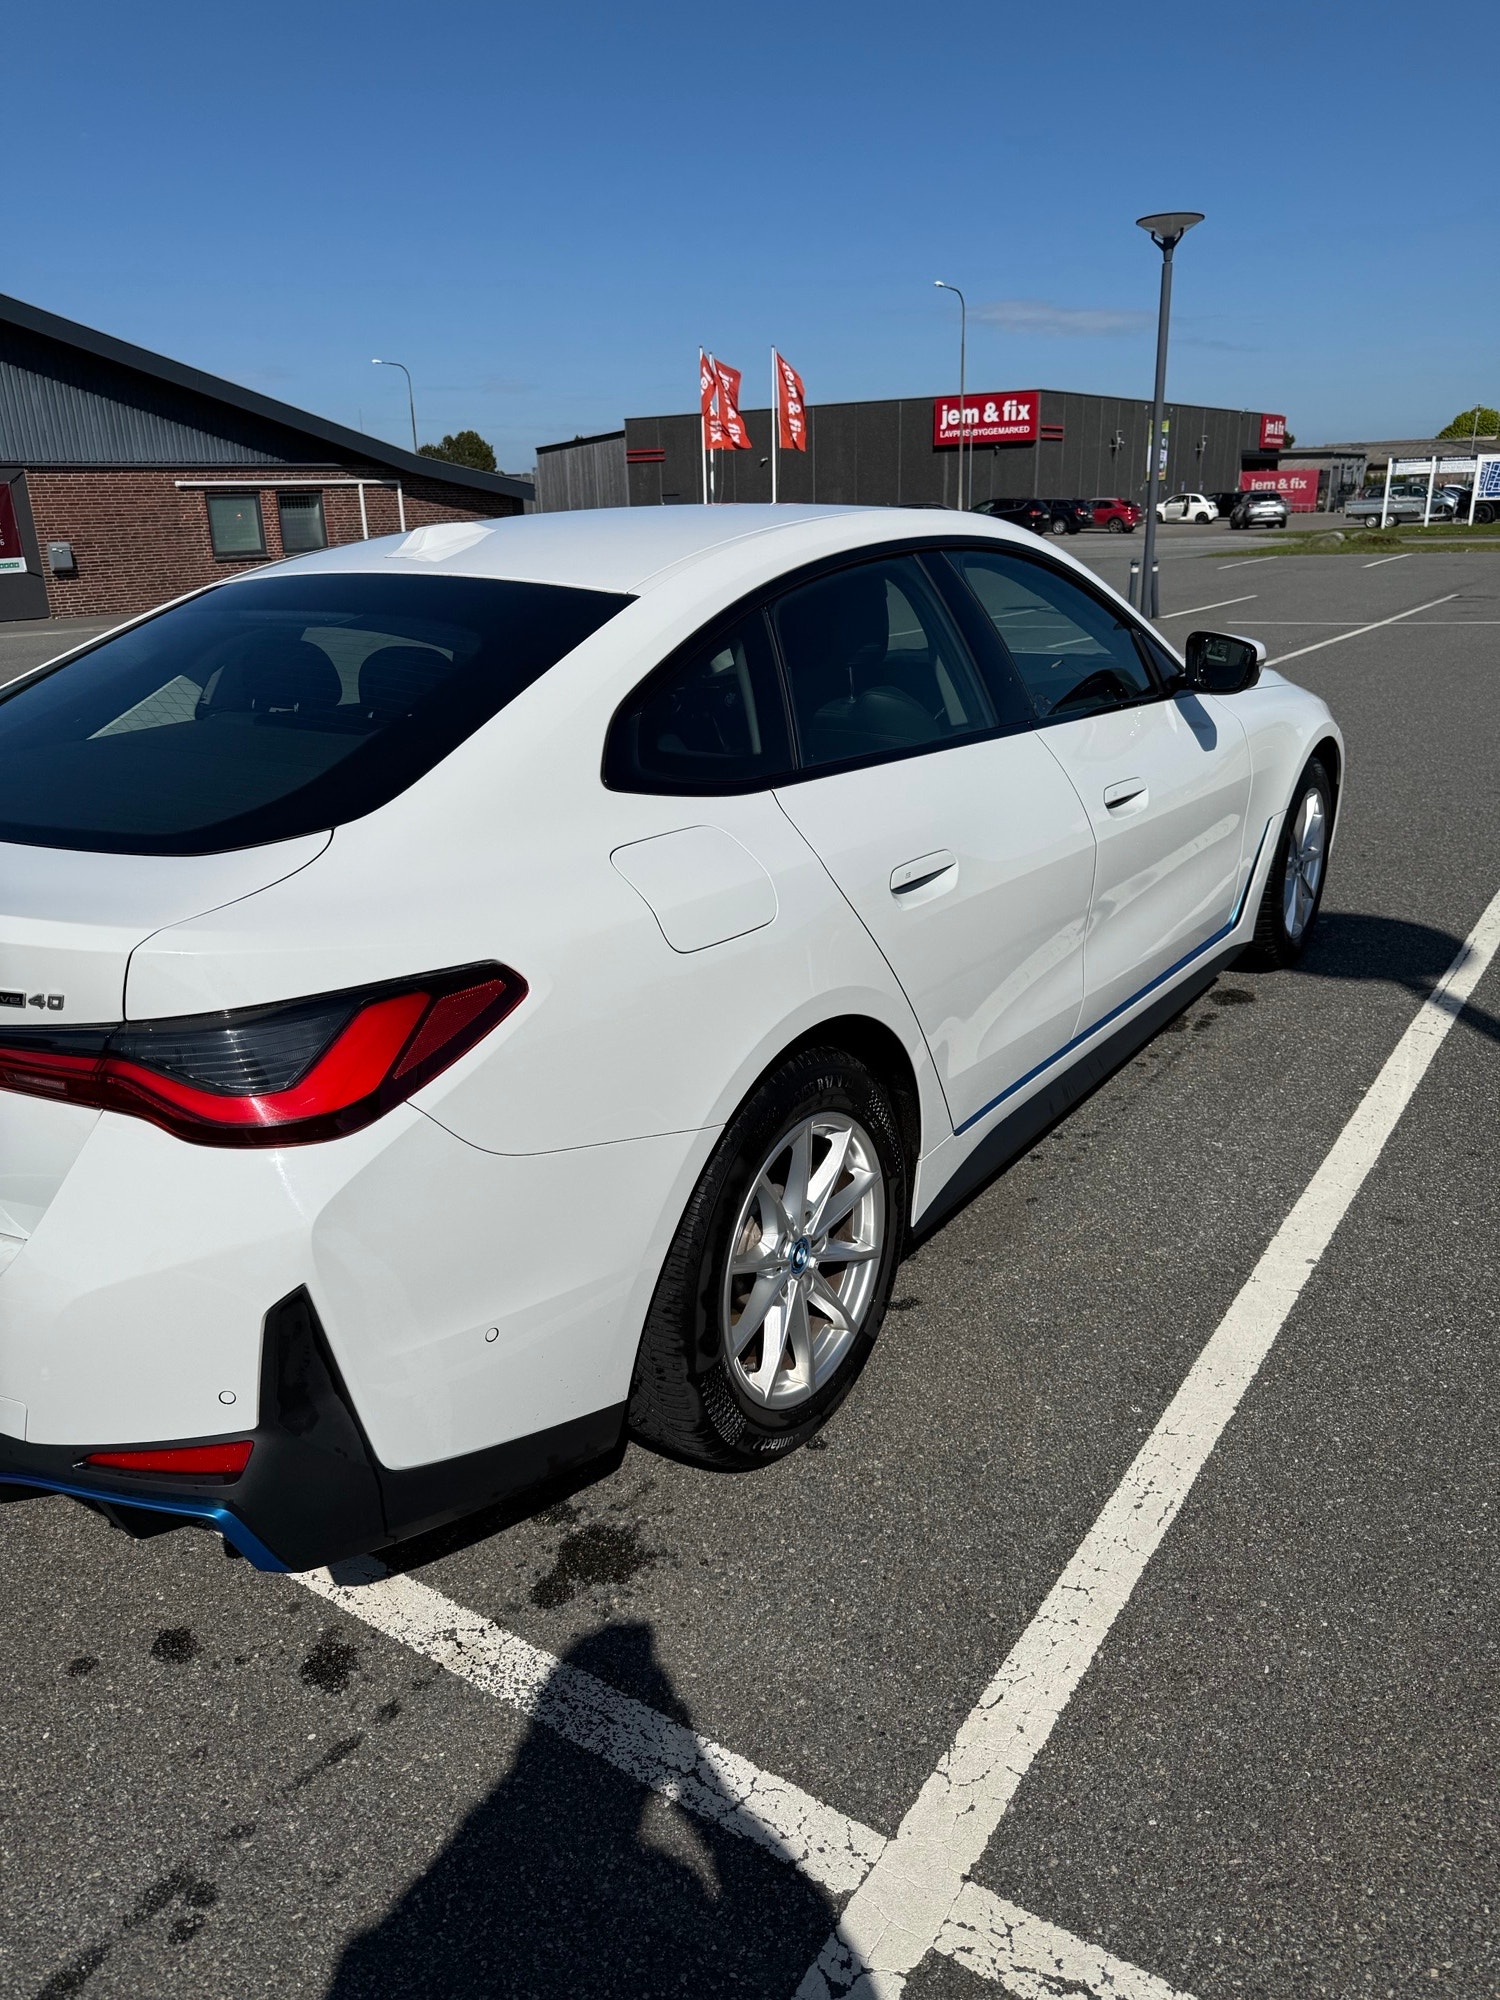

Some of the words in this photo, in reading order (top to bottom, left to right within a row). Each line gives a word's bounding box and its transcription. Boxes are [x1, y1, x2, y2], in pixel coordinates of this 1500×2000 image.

[788, 401, 801, 415] &
[940, 404, 979, 430] jem
[983, 402, 999, 423] &
[1002, 400, 1030, 422] fix
[1251, 479, 1275, 490] jem
[1278, 478, 1288, 489] &
[1290, 477, 1307, 489] fix
